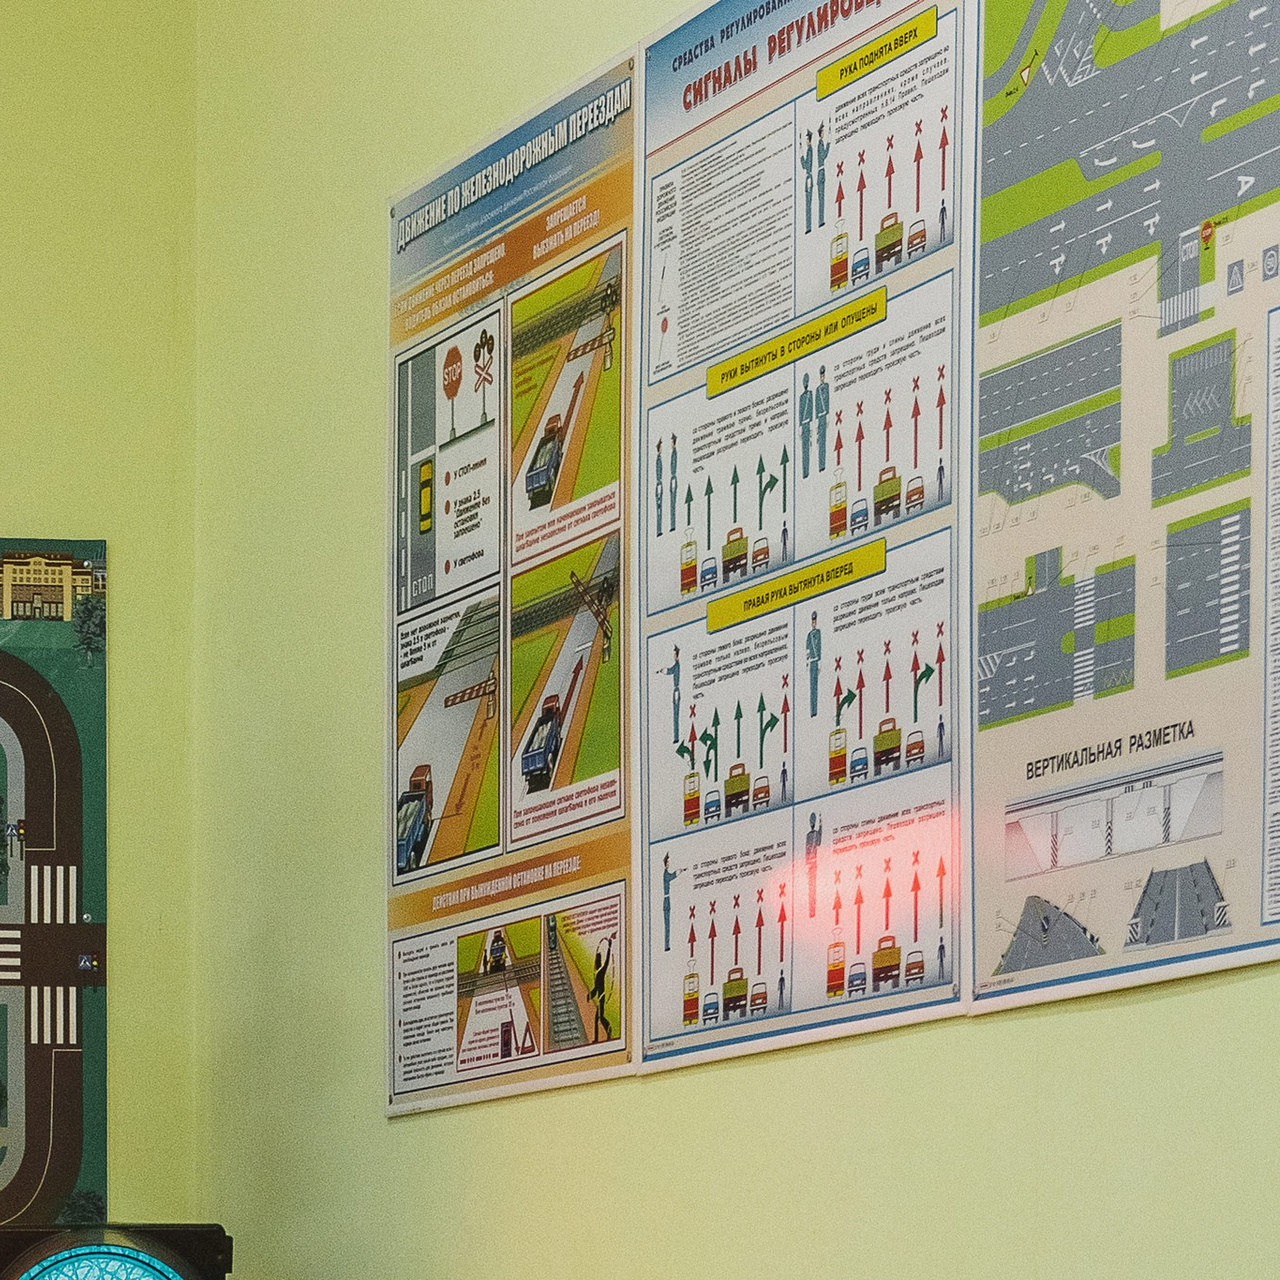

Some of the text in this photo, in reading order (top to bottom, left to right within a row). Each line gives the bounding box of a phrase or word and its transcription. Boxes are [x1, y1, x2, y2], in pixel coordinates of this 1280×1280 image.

[672, 36, 716, 72] СРЕДСТВА
[682, 46, 758, 111] СИГНАЛЫ
[839, 28, 918, 80] РУКА ПОДНЯТА ВВЕРХ
[397, 201, 446, 250] ДВИЖЕНИЕ
[447, 185, 461, 216] ПО
[461, 119, 568, 209] ЖЕЛЕЗНОДОРОЖНЫМ
[570, 78, 631, 142] ПЕРЕЕЗДАМ
[546, 195, 586, 231] ЗАПРЕЩАЕТСЯ
[1181, 239, 1198, 262] СТОП
[720, 303, 878, 384] РУКИ ВЫТЯНУТЫ В СТОРОНЫ ИЛИ ОПУЩЕНЫ
[443, 360, 462, 386] STOP
[412, 574, 434, 597] СТОП
[743, 562, 853, 612] ПРАВАЯ РУКА ВЫТЯНУТА ВПЕРЕД
[1026, 720, 1195, 780] ВЕРТИКАЛЬНАЯ РАЗМЕТКА
